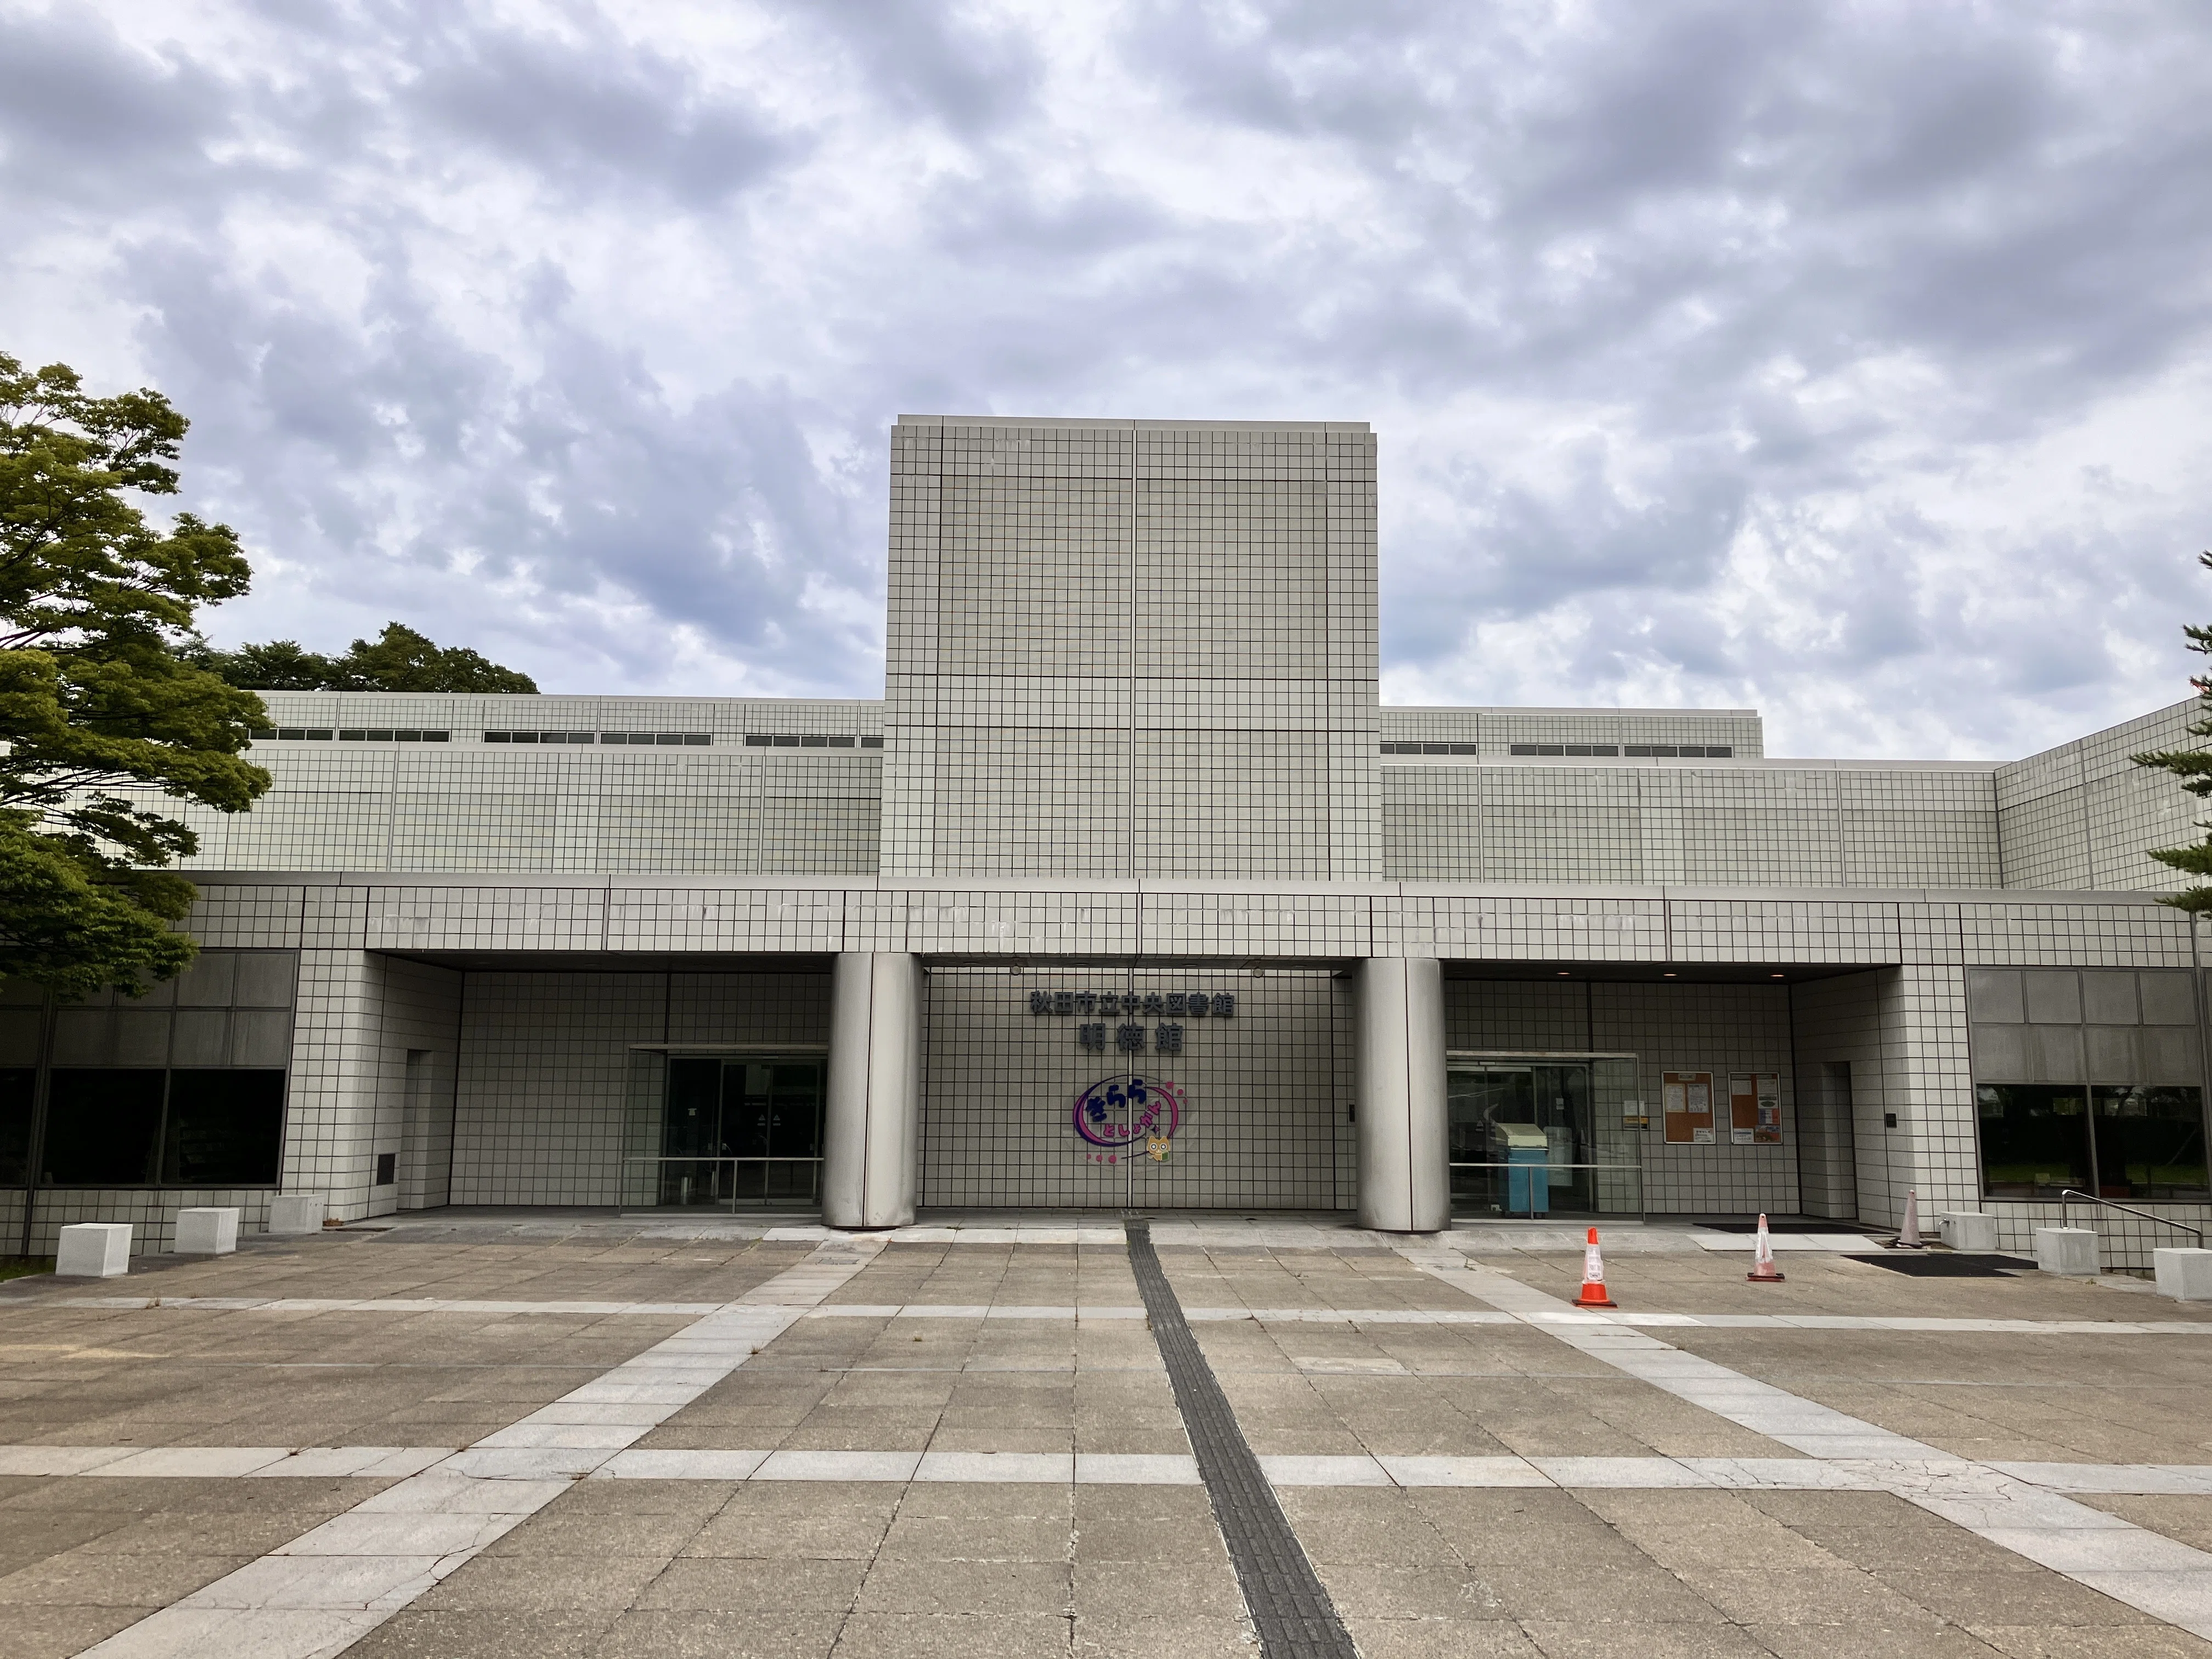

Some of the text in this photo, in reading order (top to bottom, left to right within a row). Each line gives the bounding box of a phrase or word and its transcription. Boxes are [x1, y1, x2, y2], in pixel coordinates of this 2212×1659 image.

[1030, 990, 1235, 1015] 秋田市立中央図書館
[1079, 1022, 1183, 1052] 明徳館
[1086, 1079, 1147, 1122] きらら
[1103, 1101, 1161, 1137] としょかん
